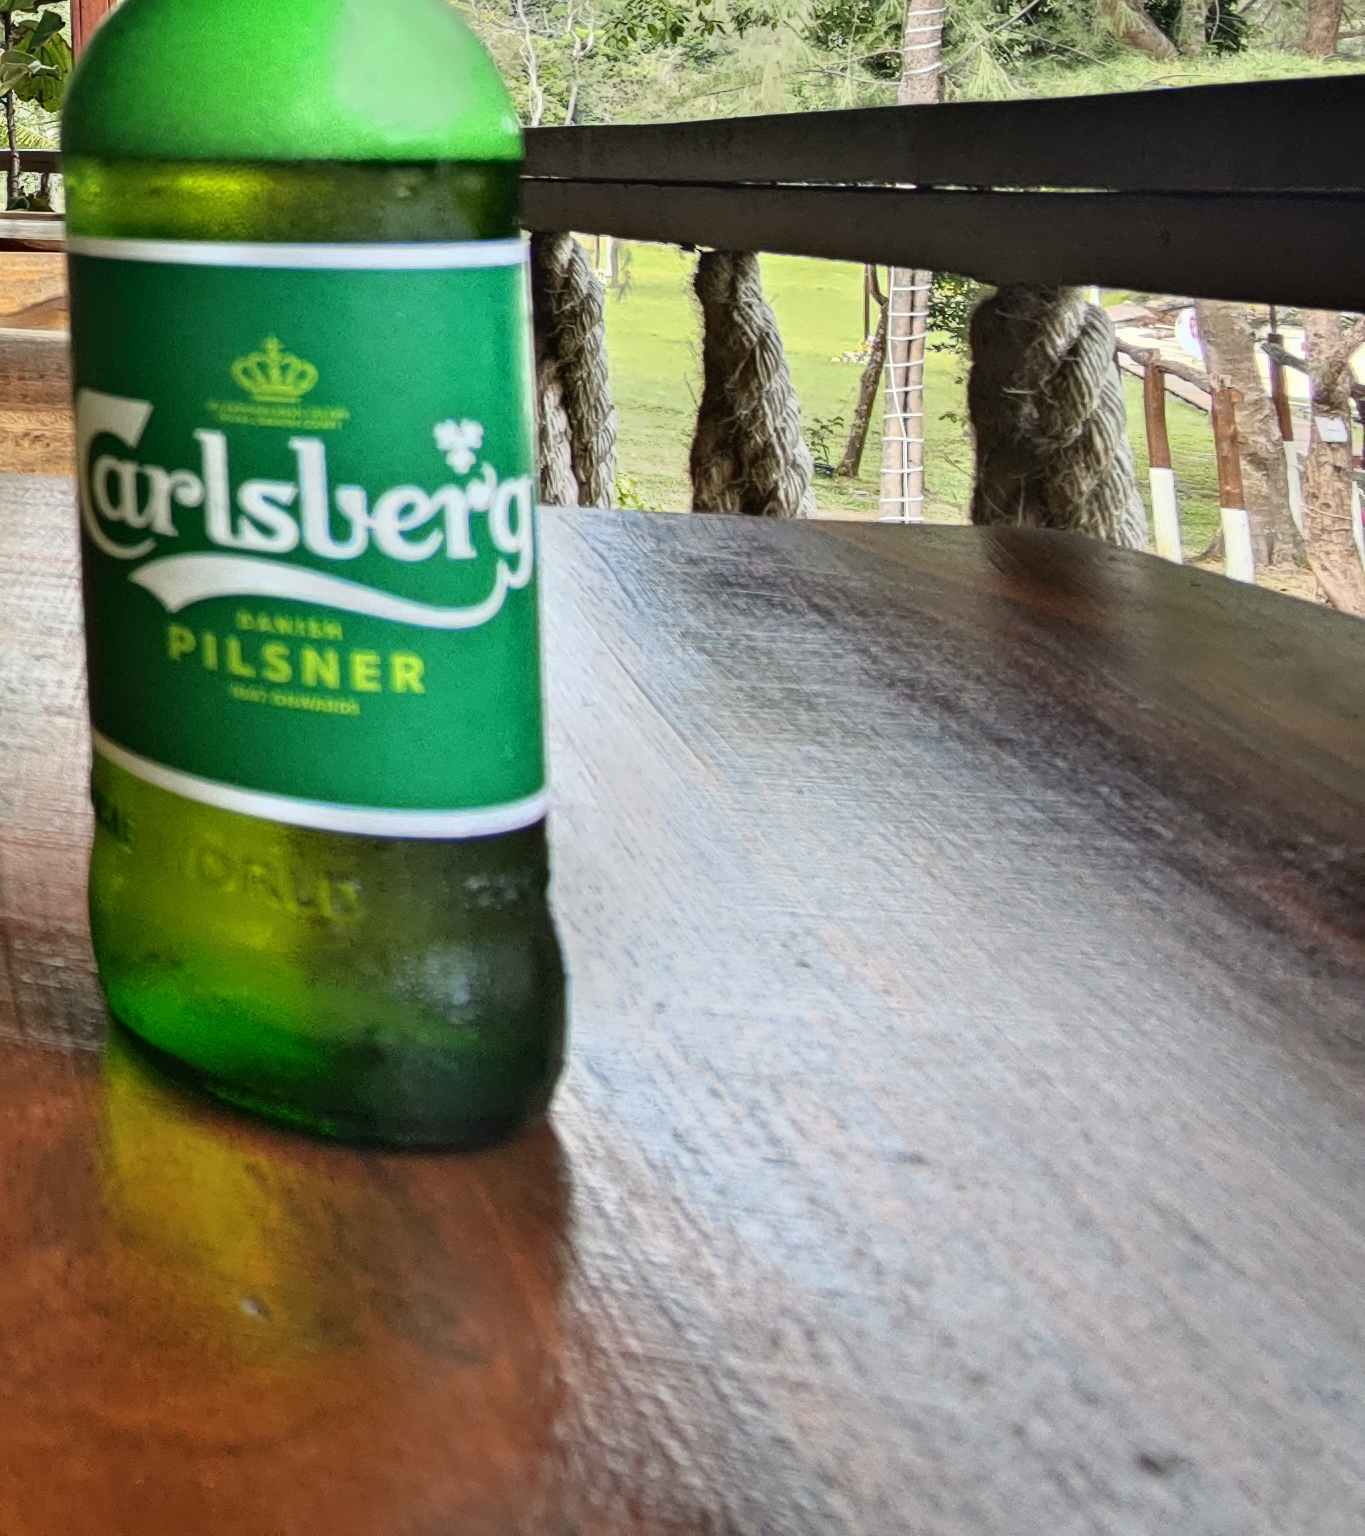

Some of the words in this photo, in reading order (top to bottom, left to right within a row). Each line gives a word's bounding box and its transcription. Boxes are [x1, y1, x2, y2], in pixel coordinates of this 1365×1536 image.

[76, 388, 535, 592] Carlsberg
[167, 622, 426, 695] PILSNER
[235, 610, 344, 641] DANISH
